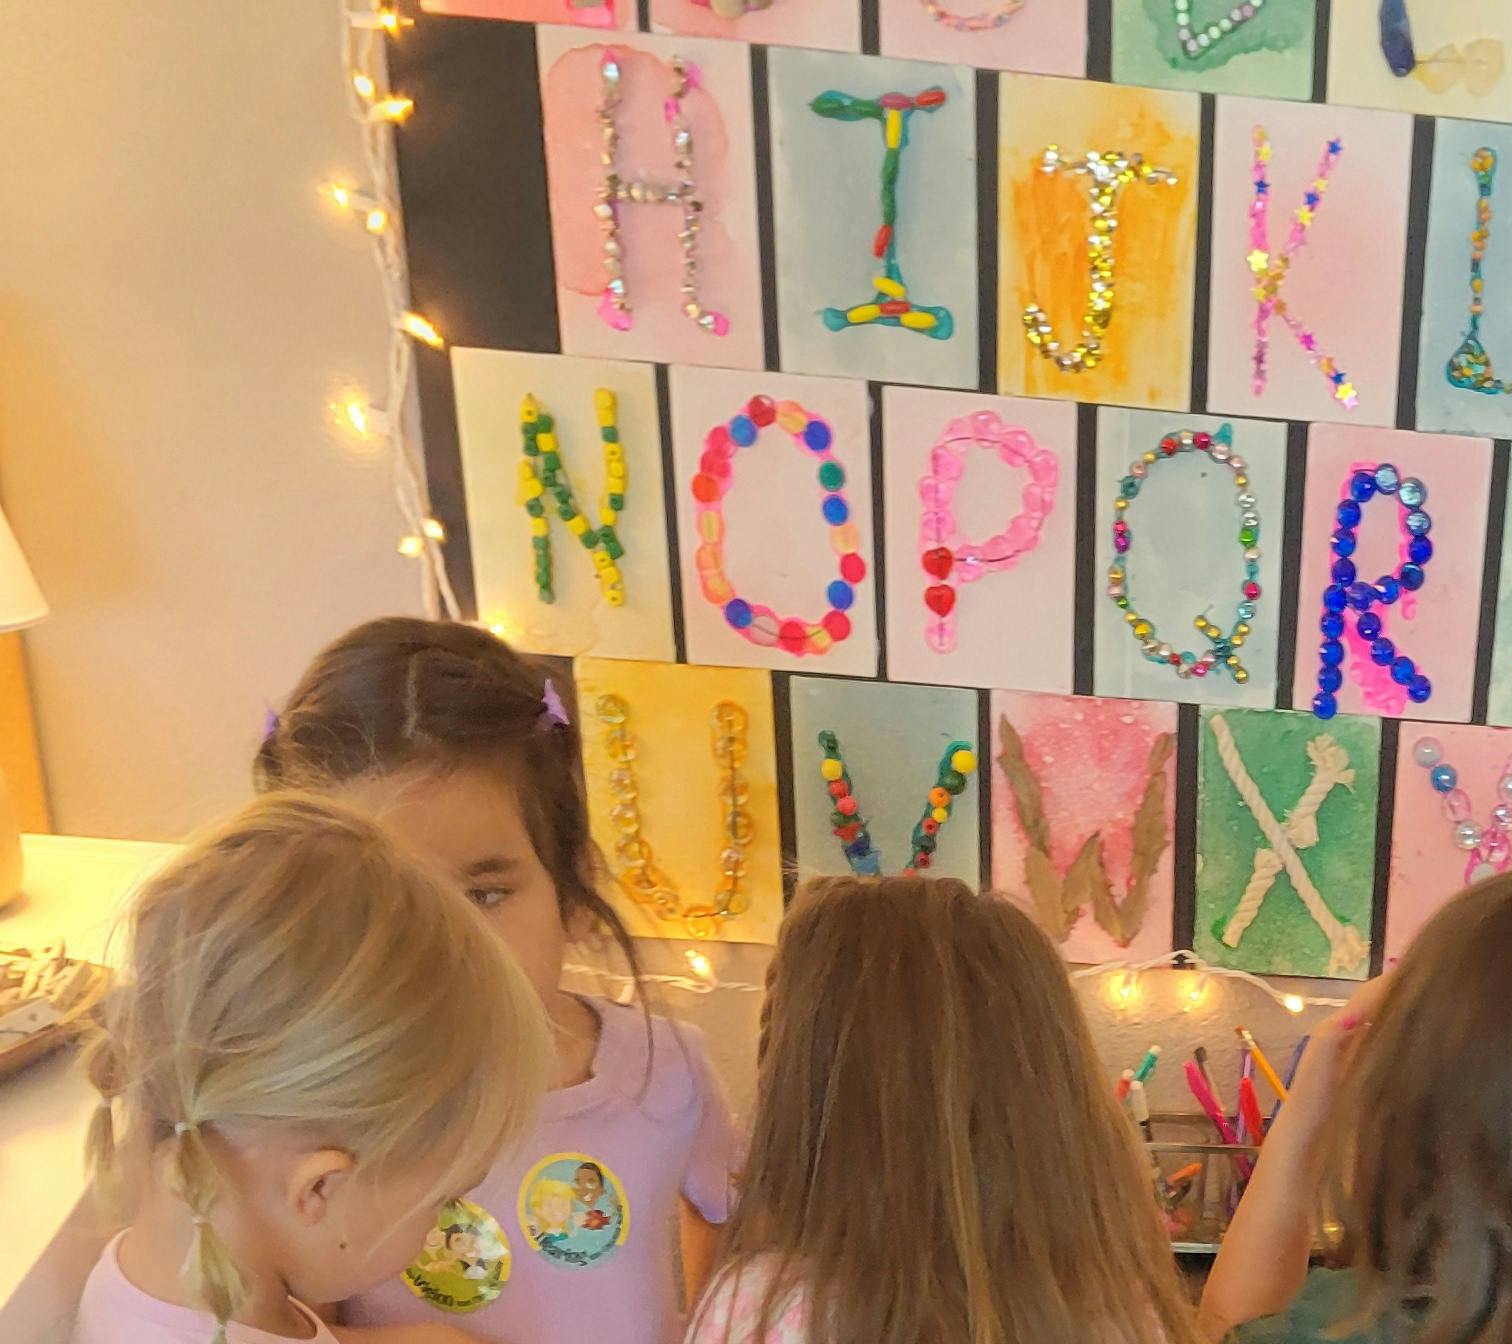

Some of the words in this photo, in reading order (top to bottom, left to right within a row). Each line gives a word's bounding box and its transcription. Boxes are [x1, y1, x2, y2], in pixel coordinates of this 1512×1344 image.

[599, 48, 732, 334] H
[809, 86, 956, 341] I
[1020, 143, 1178, 374] J
[1245, 123, 1360, 411] K
[517, 386, 626, 607] N
[691, 394, 867, 659] O
[918, 410, 1060, 654] P
[1107, 422, 1265, 686] Q
[1308, 460, 1434, 720] R
[595, 692, 754, 940] U
[817, 728, 978, 880] V
[997, 713, 1178, 949] W
[1208, 713, 1372, 977] X
